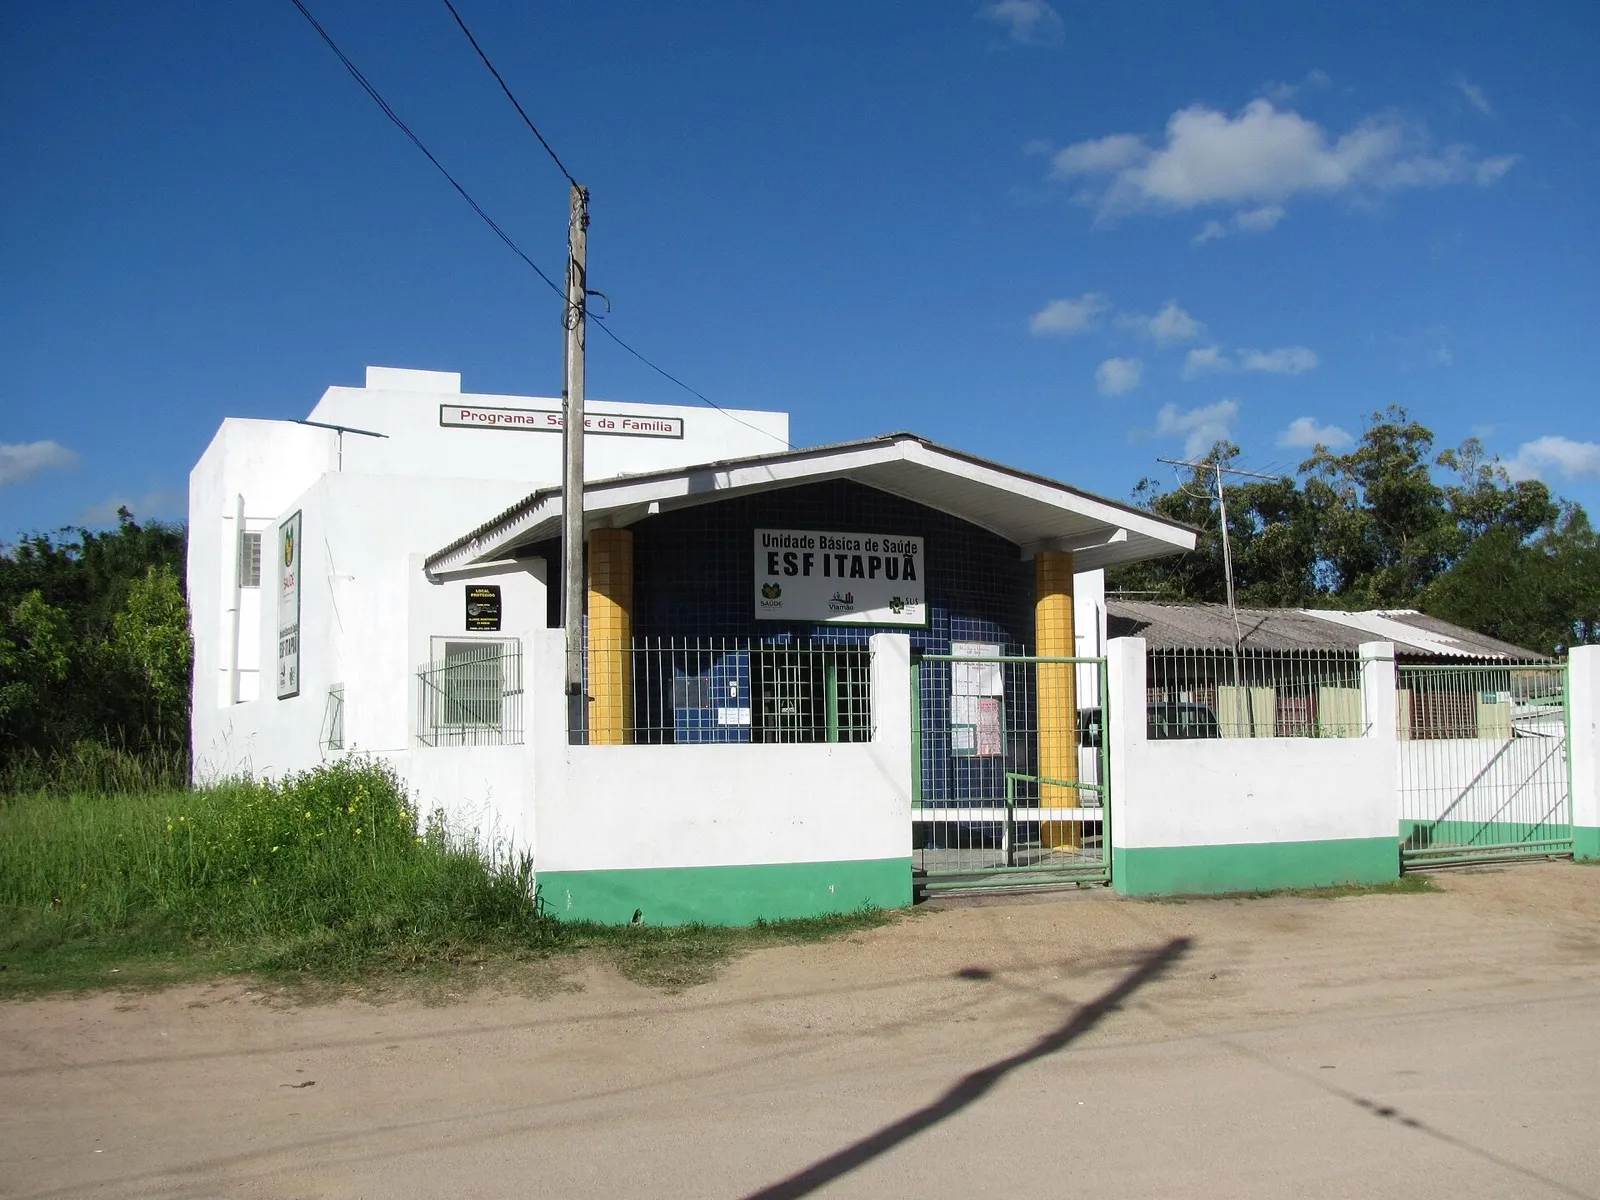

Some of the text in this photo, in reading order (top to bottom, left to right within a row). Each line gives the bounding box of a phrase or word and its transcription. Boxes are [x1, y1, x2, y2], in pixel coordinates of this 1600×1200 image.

[460, 410, 672, 432] Programa Sae da Família
[762, 533, 918, 554] Unidade Básica de Saúde
[767, 551, 917, 581] ESF ITAPUÃ
[760, 599, 782, 607] SAÚDE
[828, 603, 854, 611] Viamão
[905, 597, 919, 605] SUS
